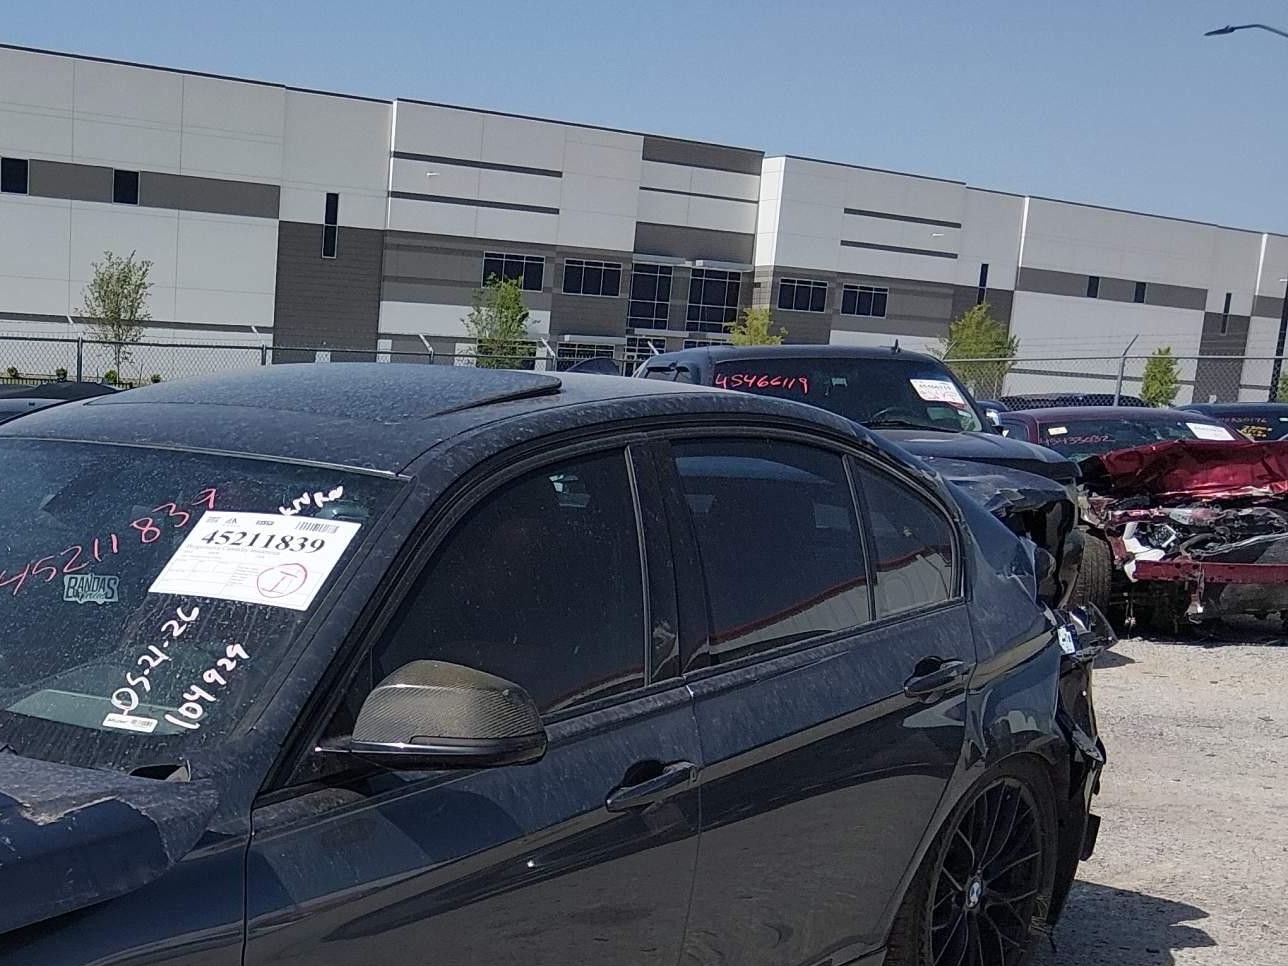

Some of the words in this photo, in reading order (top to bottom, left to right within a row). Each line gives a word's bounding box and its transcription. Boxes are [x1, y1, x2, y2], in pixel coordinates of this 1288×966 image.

[715, 373, 809, 394] 45466119
[201, 529, 325, 554] 45211839
[65, 576, 118, 599] BANDAS
